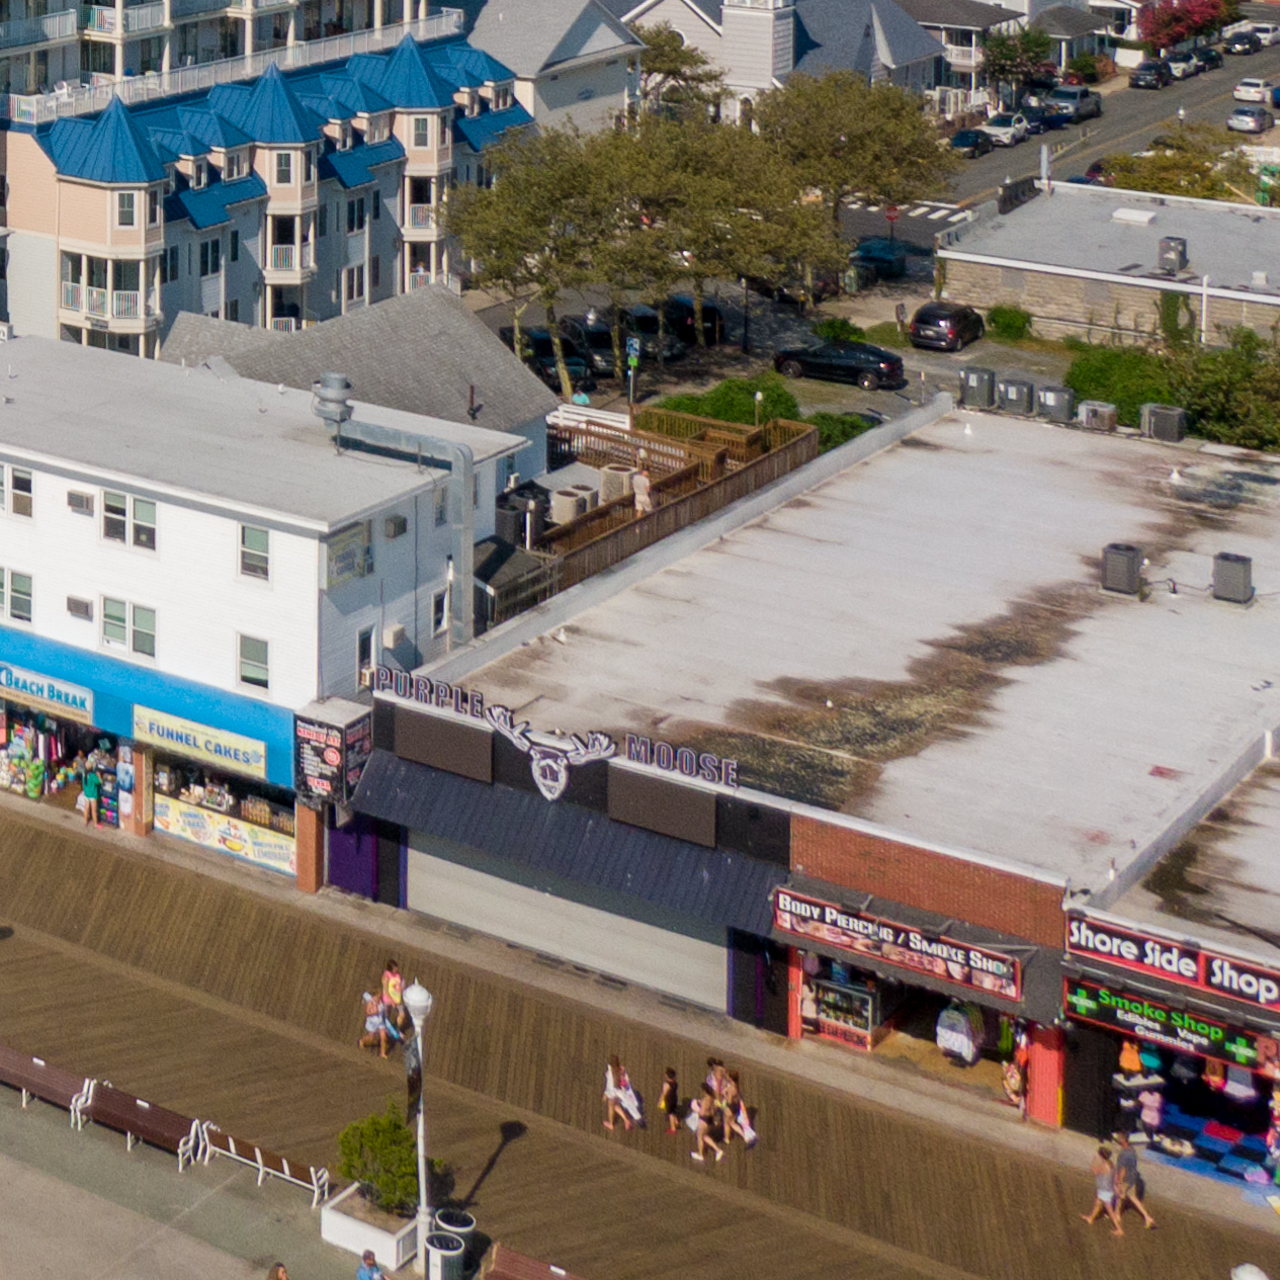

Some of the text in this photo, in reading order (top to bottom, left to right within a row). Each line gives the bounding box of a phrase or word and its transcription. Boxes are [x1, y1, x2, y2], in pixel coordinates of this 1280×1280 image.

[149, 722, 200, 749] FUNNEL
[204, 740, 251, 764] CAKES
[374, 666, 739, 788] PURPLE MOOSE
[778, 893, 821, 920] BODY
[897, 932, 905, 944] /
[909, 932, 966, 964] SMOKE
[969, 950, 1013, 977] SHO
[1069, 921, 1279, 1004] Shore Side Shop
[1098, 989, 1224, 1041] Smoke Shop
[1116, 1009, 1161, 1031] Edibles
[1135, 1025, 1195, 1052] Gummies
[1177, 1027, 1209, 1046] Vape
